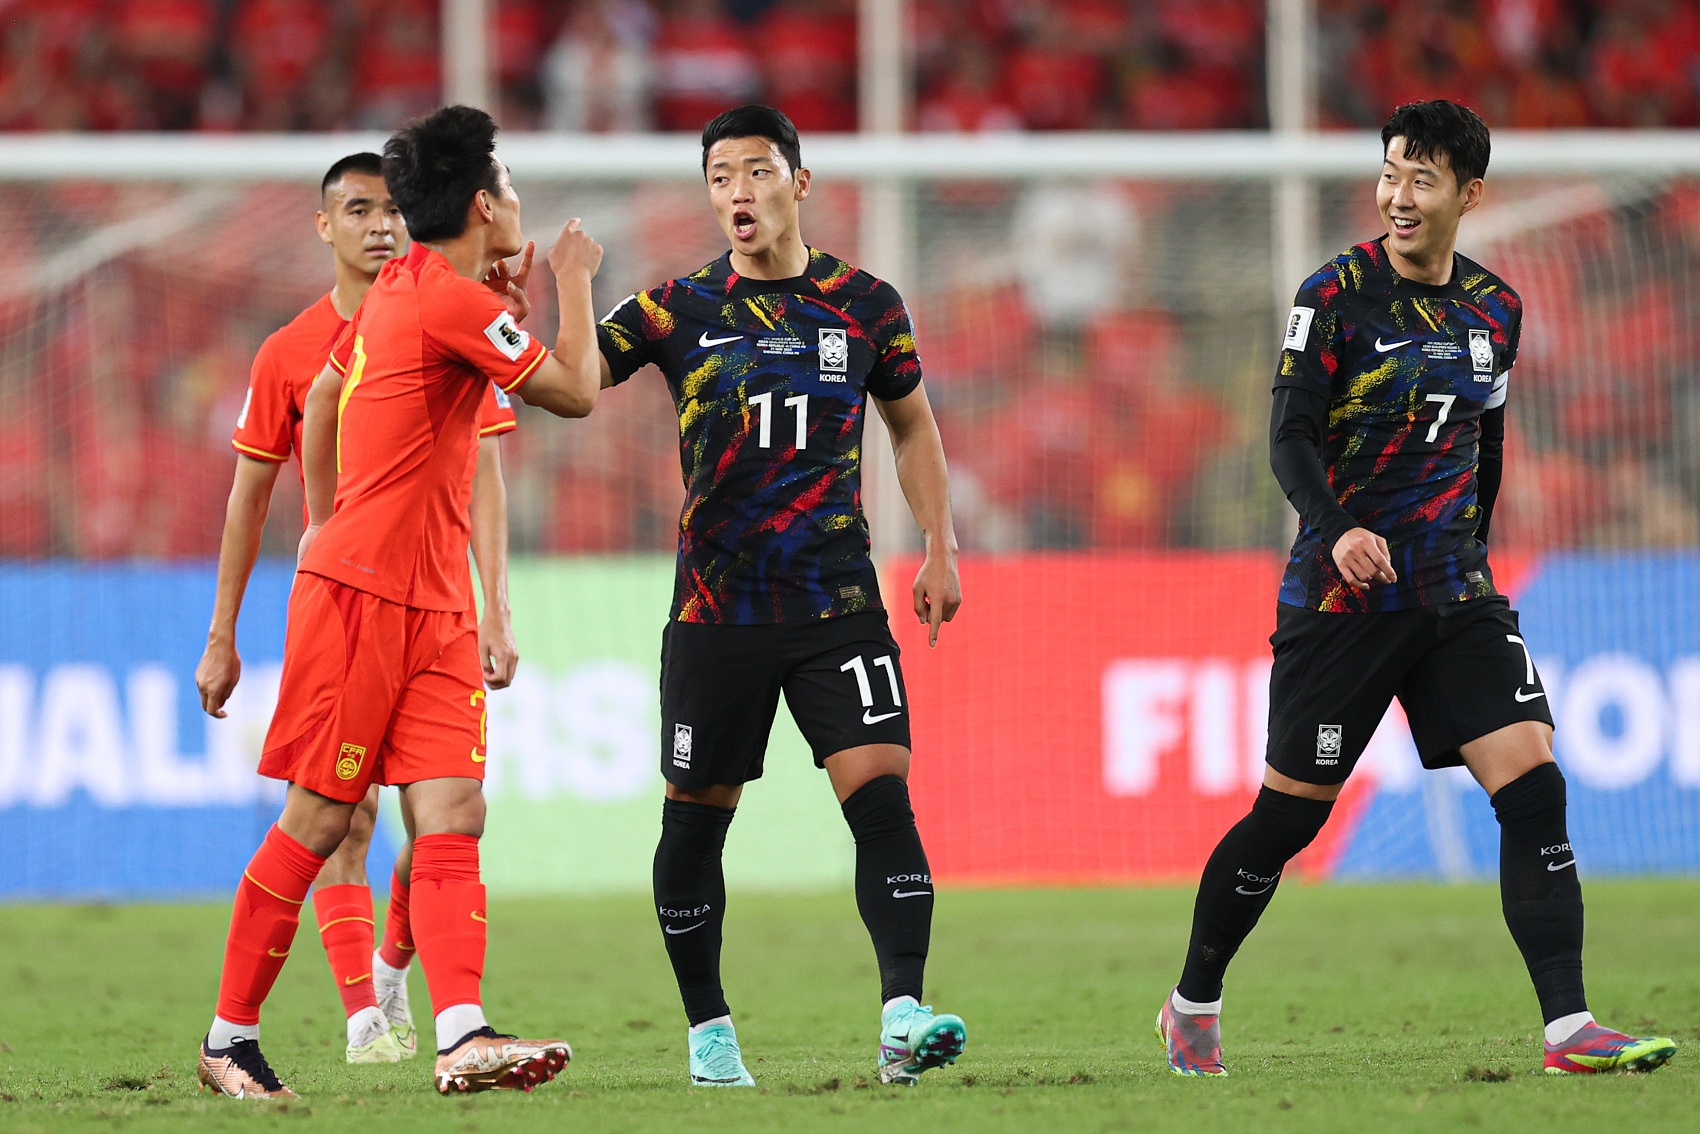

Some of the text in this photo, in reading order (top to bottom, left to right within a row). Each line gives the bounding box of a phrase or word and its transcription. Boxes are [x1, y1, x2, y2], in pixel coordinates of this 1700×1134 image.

[819, 374, 847, 383] KOREA
[1473, 374, 1492, 383] KOREA
[748, 392, 809, 450] 11
[1425, 394, 1457, 443] 7
[1506, 634, 1535, 685] 7
[840, 655, 902, 708] 11
[1315, 758, 1339, 766] KOREA
[660, 903, 711, 918] KOREA
